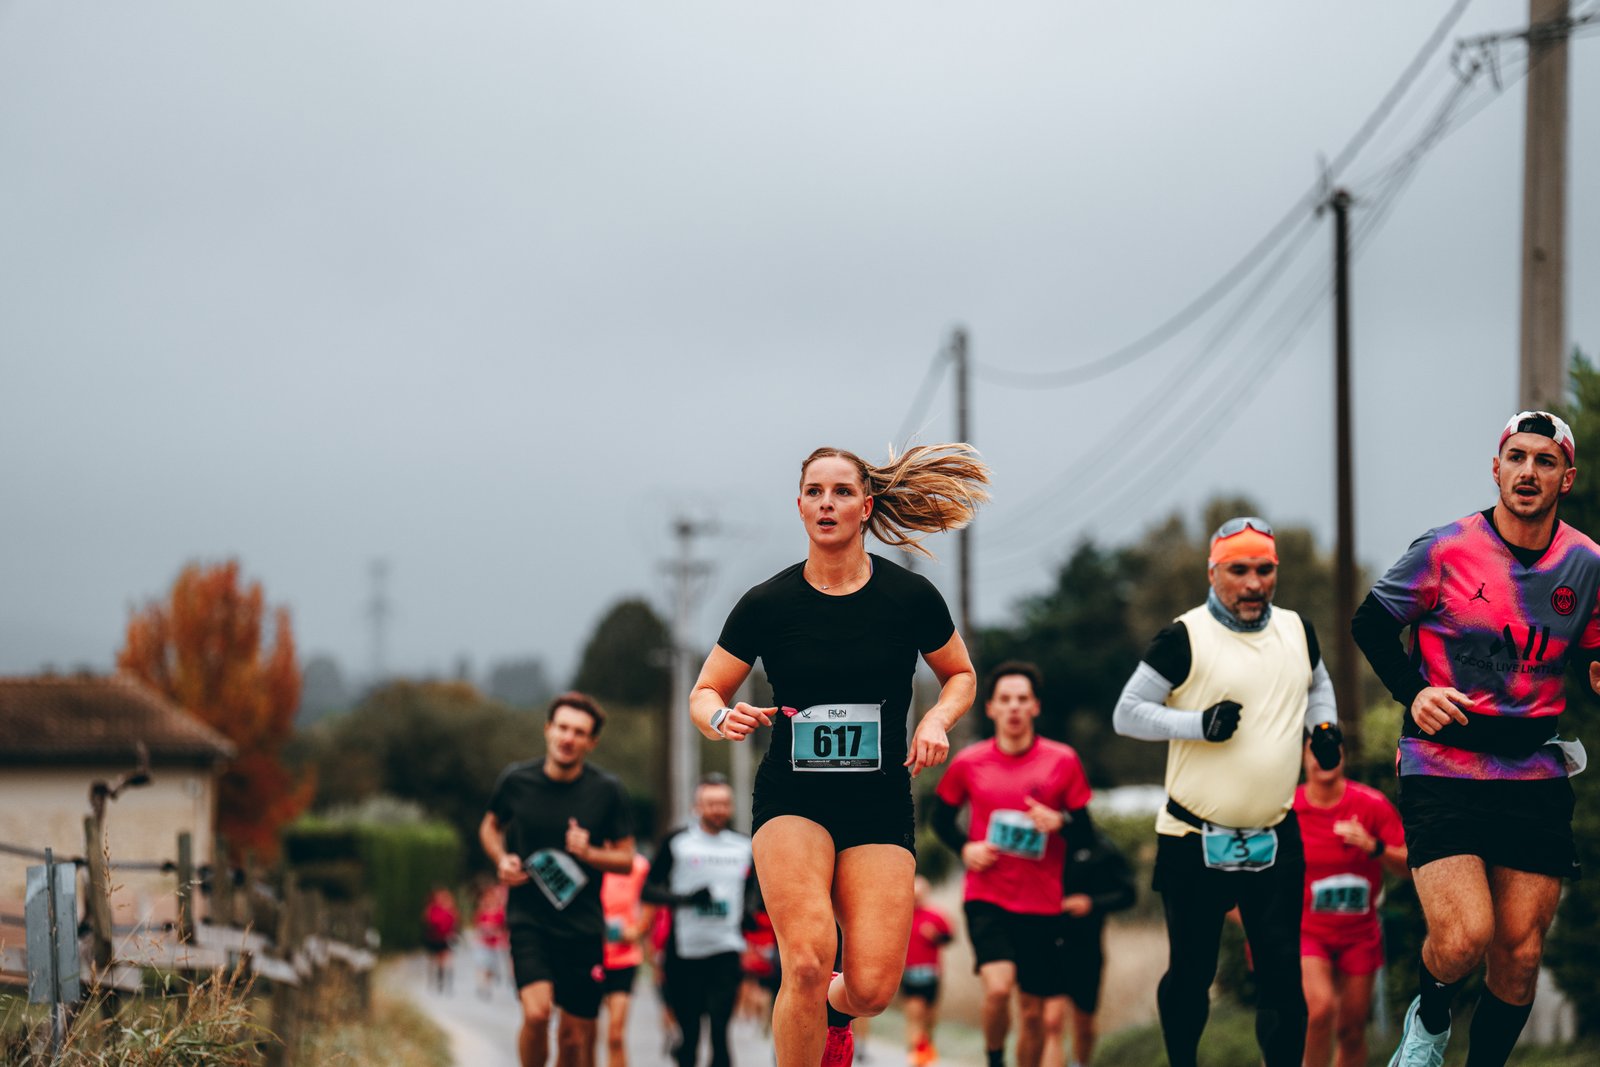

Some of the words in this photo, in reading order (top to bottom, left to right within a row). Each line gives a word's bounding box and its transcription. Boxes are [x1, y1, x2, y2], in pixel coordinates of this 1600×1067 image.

[1454, 653, 1493, 671] ACCOR
[1496, 661, 1519, 673] LIVE
[1521, 664, 1564, 675] LIMITL
[813, 724, 862, 758] 617
